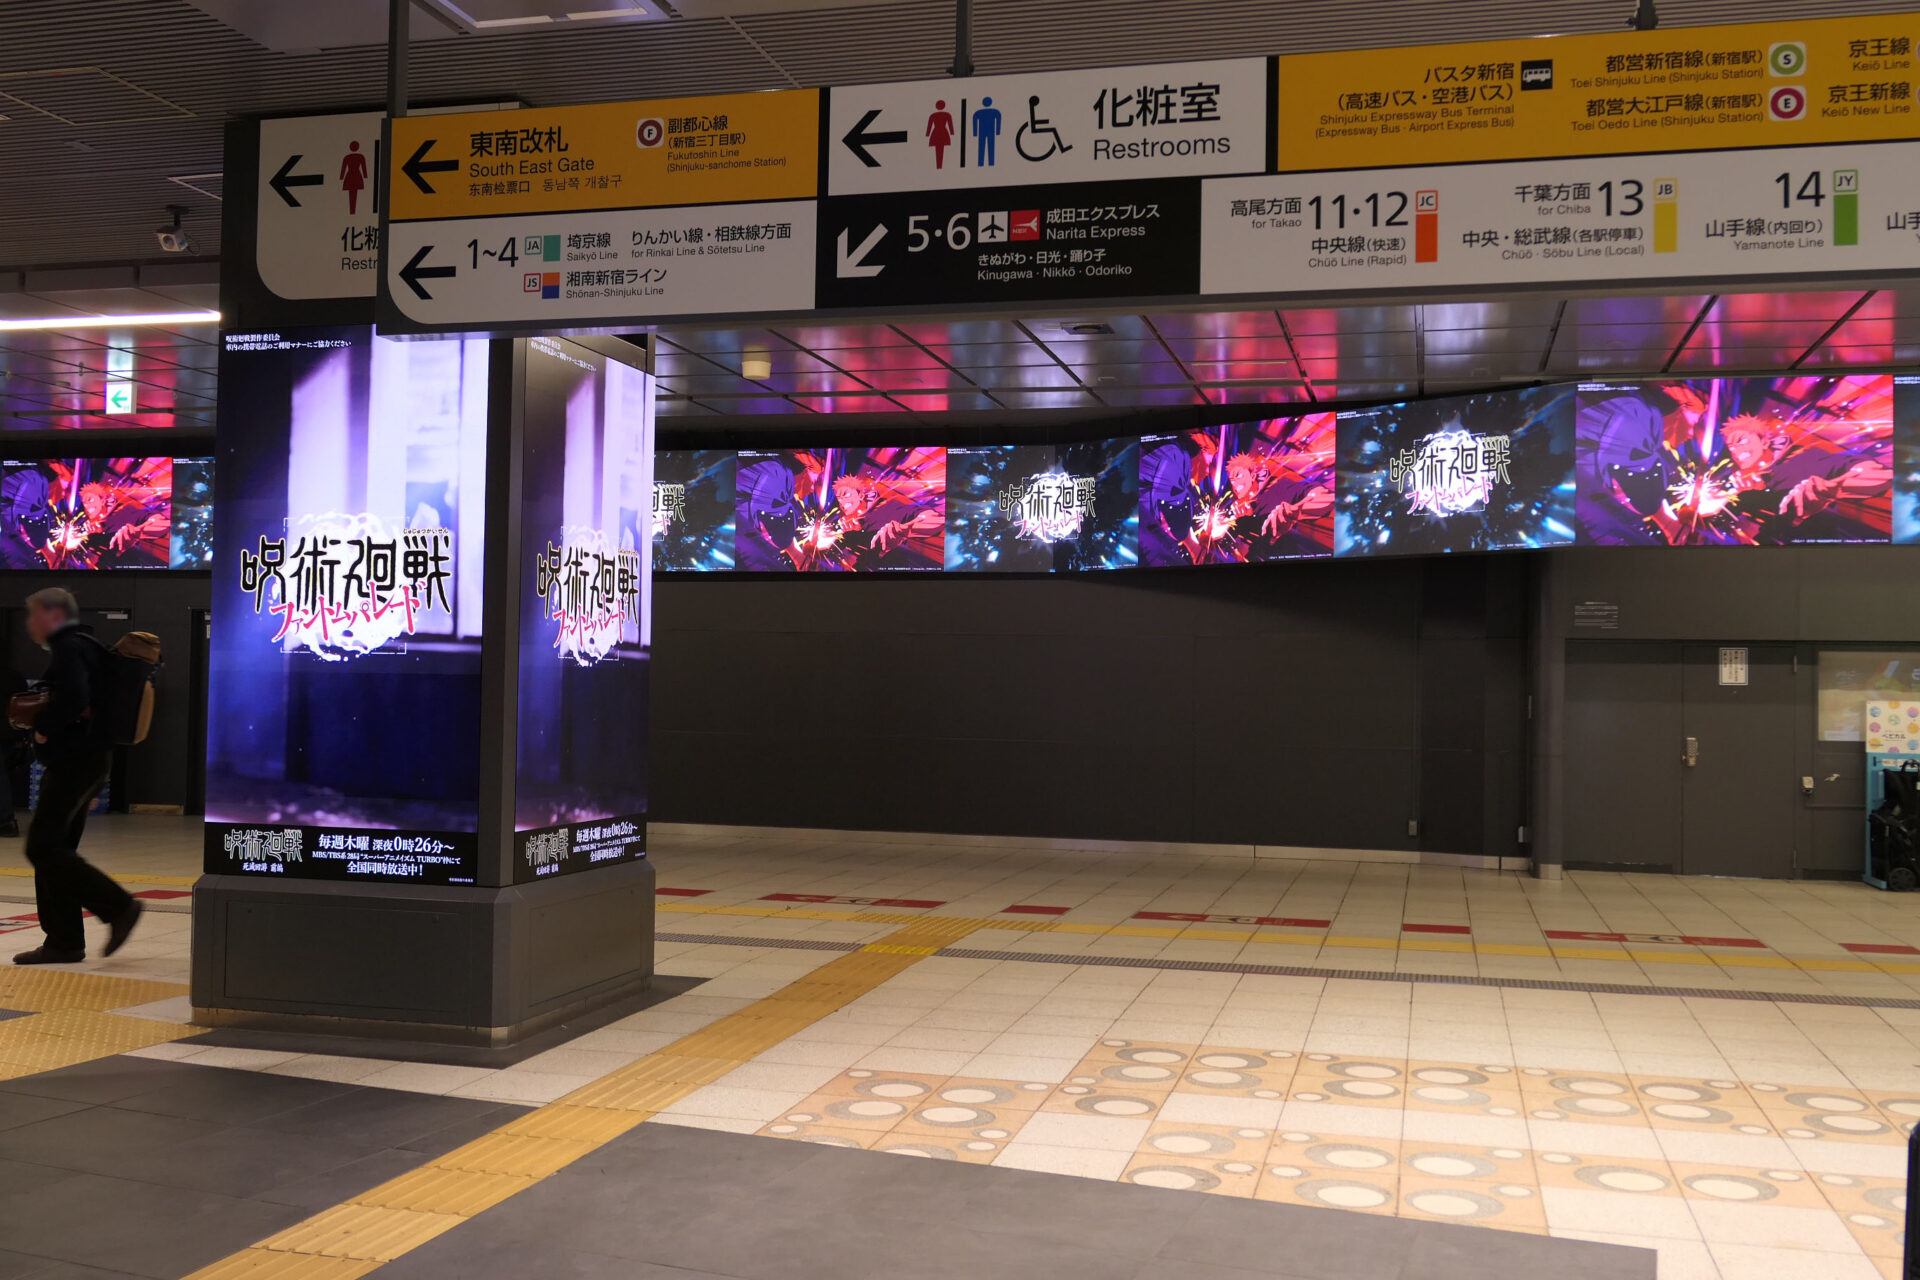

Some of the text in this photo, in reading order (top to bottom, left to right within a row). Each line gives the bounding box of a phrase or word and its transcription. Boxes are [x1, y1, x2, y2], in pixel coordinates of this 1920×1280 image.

[1848, 36, 1911, 58] 京王線
[1782, 53, 1792, 65] S
[1884, 59, 1910, 70] Line
[1424, 63, 1515, 84] バスタ新宿
[1571, 68, 1764, 88] Toei Shinjuku Line (Shinjuku Station)
[1828, 81, 1911, 104] 京王新線
[1093, 83, 1221, 129] 化粧室
[1783, 97, 1791, 109] E
[1853, 105, 1880, 116] New
[1884, 104, 1911, 115] Line
[667, 115, 728, 134] 副都心線
[1320, 104, 1515, 126] Shinjuku Expressway Bus Terminal
[1571, 111, 1764, 131] Toei Oedo Line (Shinjuku Station)
[647, 128, 654, 138] F
[1315, 117, 1515, 139] (Expressway Bus Airport Express Bus)
[469, 125, 569, 158] 東南改札
[1094, 134, 1231, 161] Restrooms
[667, 148, 740, 161] Fukutoshin Line
[470, 157, 595, 178] South East Gate
[667, 157, 787, 173] (Shinjuku-sanchome Station)
[468, 180, 530, 197] 东南检票口
[542, 174, 623, 192] 동남쪽 개찰구
[1657, 184, 1673, 196] JB
[1775, 171, 1826, 208] 14
[1837, 175, 1854, 187] JY
[1419, 195, 1435, 207] JC
[1514, 182, 1591, 203] 千葉方面
[1597, 179, 1644, 217] 13
[1046, 204, 1161, 224] 成田エクスプレス
[1230, 197, 1302, 217] 高尾方面
[1537, 203, 1591, 216] for Chiba
[1251, 217, 1302, 229] for Takao
[567, 222, 792, 250] 埼京線 りんかい線・相鉄線方面
[1046, 225, 1146, 241] Narita Express
[526, 240, 540, 251] JA
[599, 250, 618, 260] Line
[631, 249, 644, 258] for
[646, 248, 674, 257] Rinkai
[677, 247, 696, 257] Line
[698, 247, 705, 256] &
[745, 243, 765, 254] Line
[1577, 246, 1601, 257] Line
[1604, 245, 1645, 257] (Local)
[1734, 237, 1825, 251] Yamanote Line
[977, 248, 1107, 267] きぬがわ・日光・踊り子
[1341, 256, 1364, 267] Line
[1367, 255, 1407, 267] (Rapid)
[526, 277, 538, 288] JS
[566, 268, 667, 287] 湘南新宿ライン
[977, 265, 1132, 282] Kinugawa Nikkō Odoriko
[645, 286, 664, 297] Line
[1390, 436, 1512, 494] 呪術廻戦
[999, 477, 1097, 521] 呪術廻戦
[241, 535, 452, 614] 呪術廻戦
[537, 540, 640, 628] 呪術廻戦
[270, 580, 427, 642] ファントムパレード
[224, 829, 303, 863] 呪術廻戦
[318, 833, 370, 851] 毎週木曜
